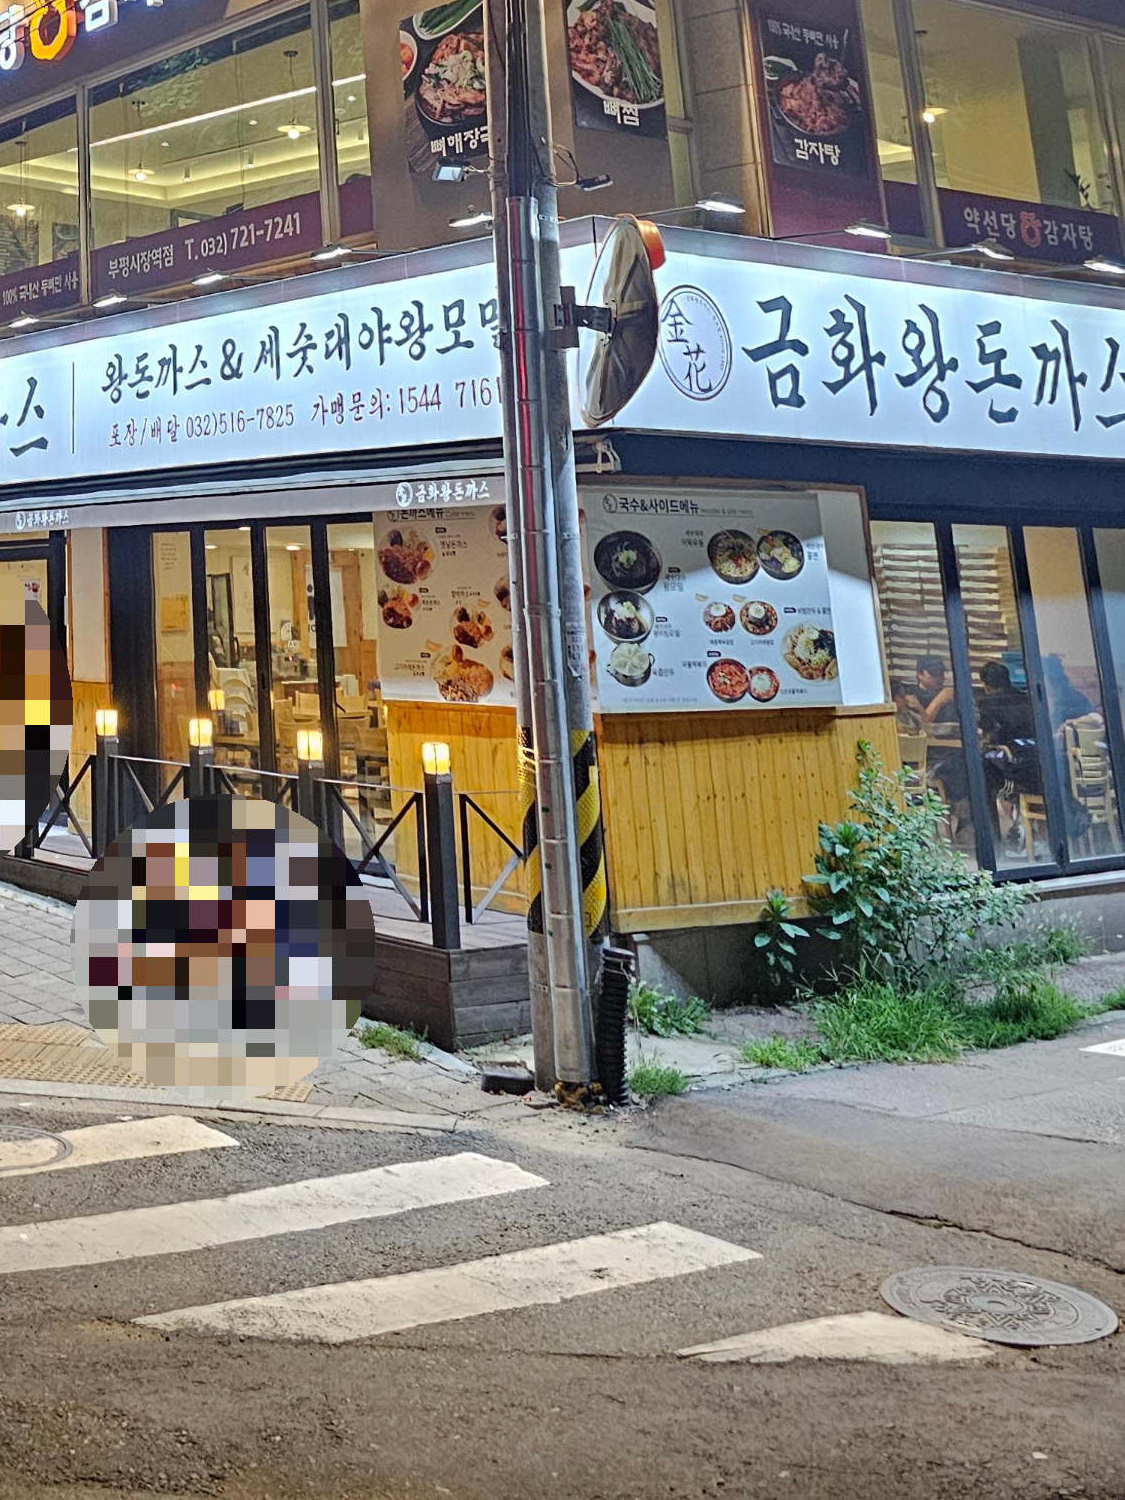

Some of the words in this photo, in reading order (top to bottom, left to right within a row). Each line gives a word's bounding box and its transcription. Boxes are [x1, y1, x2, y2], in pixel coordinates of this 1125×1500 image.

[794, 137, 842, 167] 감자탕
[108, 243, 174, 280] 부평시장역점
[230, 211, 301, 251] 721-7241
[963, 206, 1017, 240] 약선당
[1042, 219, 1094, 252] 감자탕
[2, 286, 18, 307] 100%
[19, 280, 40, 301] 국내산
[63, 271, 79, 291] 사용
[108, 413, 180, 450] 포장/배달
[185, 402, 296, 440] 032)516-7825
[399, 383, 442, 415] 1544
[415, 479, 491, 505] 금화왕돈까스
[618, 496, 700, 515] 국수&사이드메뉴
[26, 509, 70, 528] 금화왕돈까스
